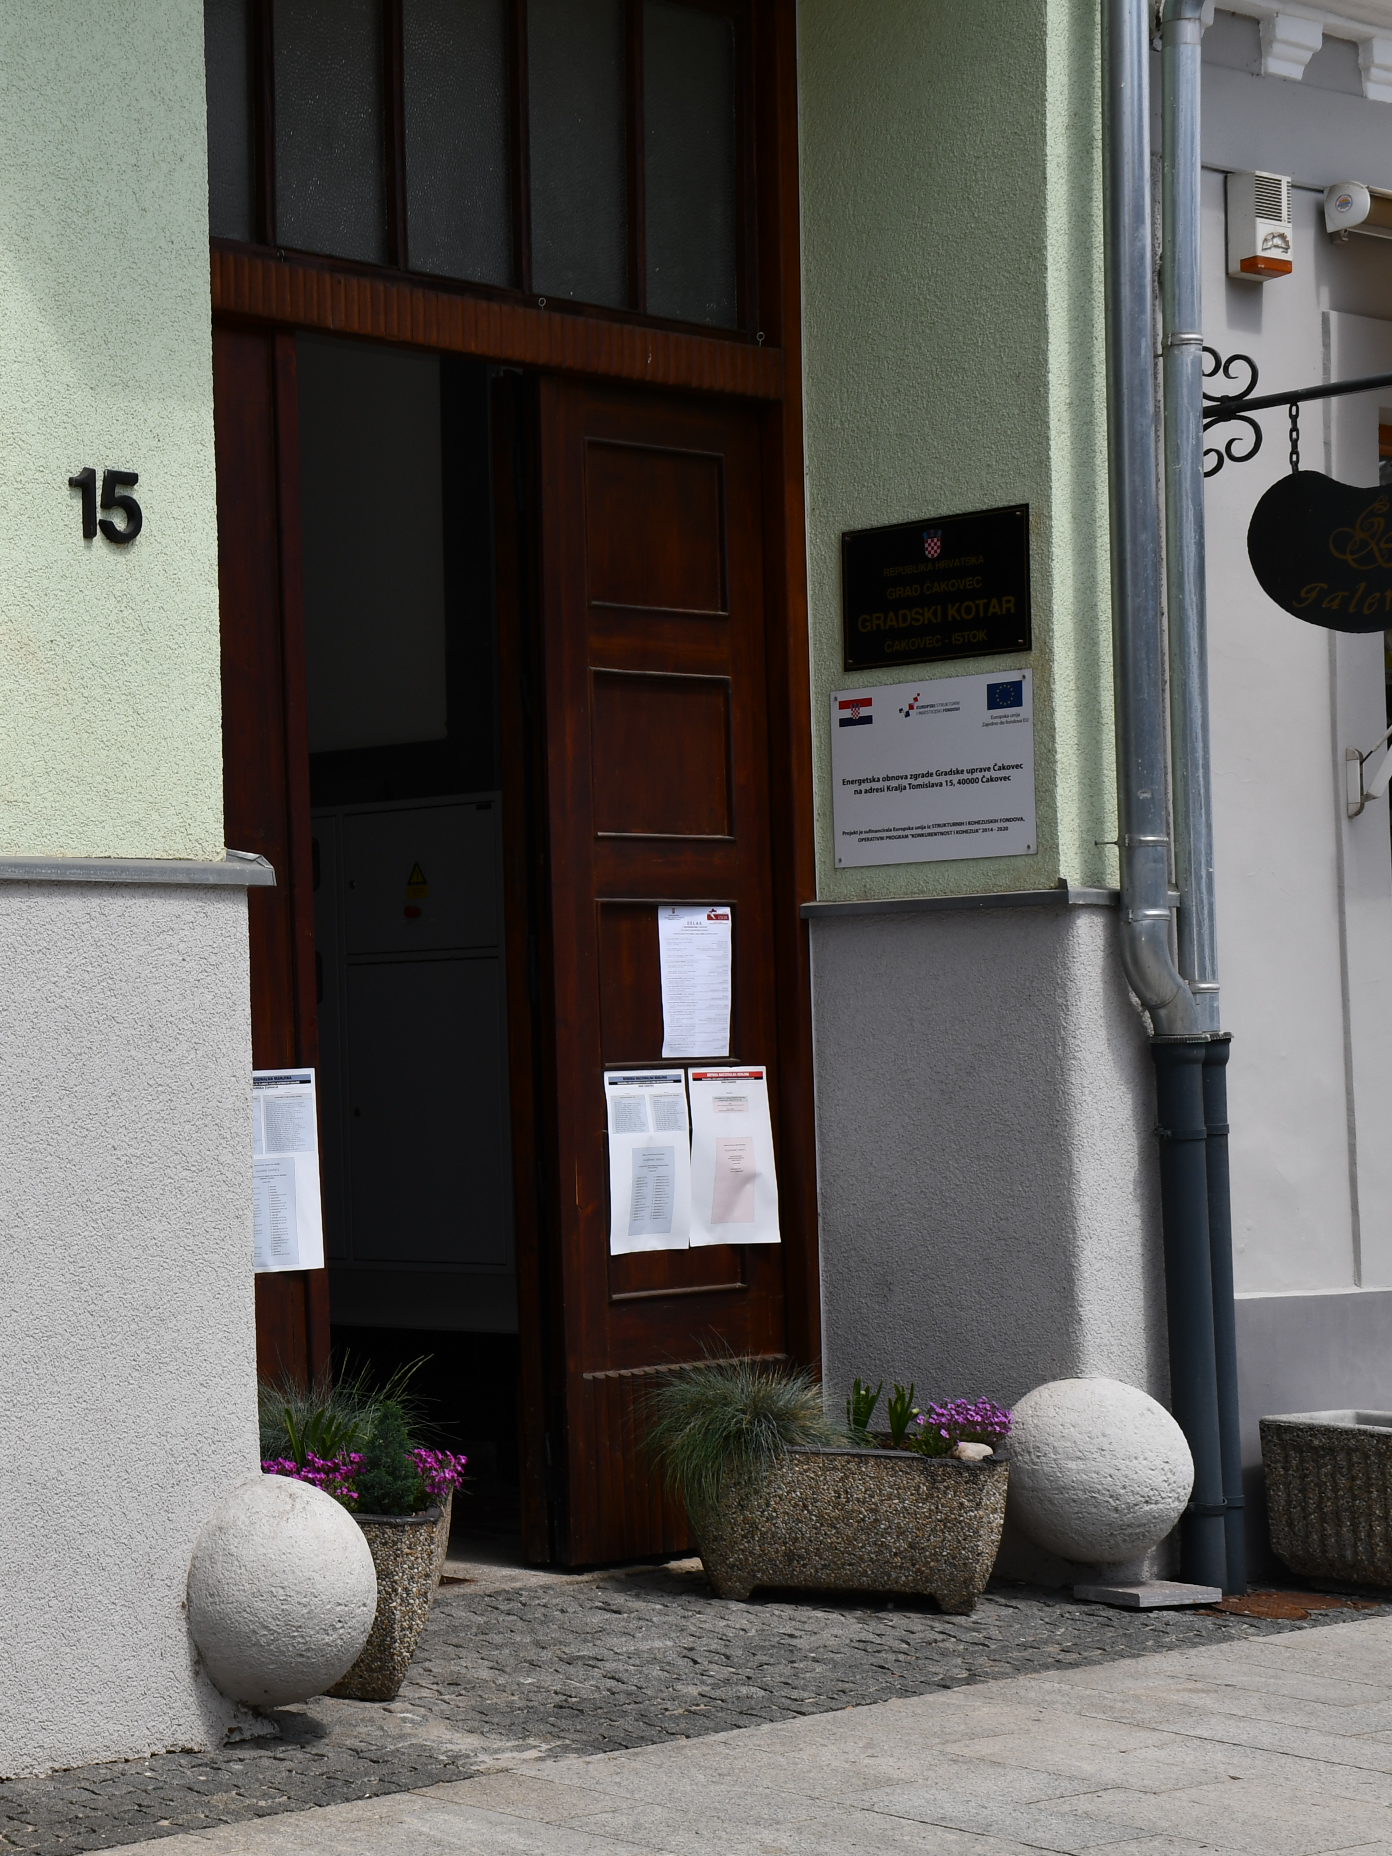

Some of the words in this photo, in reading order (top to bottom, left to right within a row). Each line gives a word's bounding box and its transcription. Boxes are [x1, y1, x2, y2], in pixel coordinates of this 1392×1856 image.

[68, 467, 142, 543] 15
[883, 564, 933, 577] REPUBLIKA
[935, 556, 985, 570] HRVATSKA
[886, 585, 921, 600] GRAD
[858, 605, 943, 632] GRADSKI
[948, 596, 1015, 621] KOTAR
[952, 629, 988, 645] ISTOK
[842, 774, 881, 787] Energetska
[882, 772, 908, 782] obnova
[909, 770, 934, 781] zgrade
[935, 767, 965, 777] Gradske
[966, 766, 991, 776] uprave
[992, 762, 1024, 772] Čakovec
[854, 787, 863, 795] na
[864, 785, 886, 794] adresi
[886, 783, 907, 793] Kralja
[908, 780, 943, 790] Tomislava
[945, 779, 955, 788] 15,
[957, 776, 980, 786] 40000
[980, 774, 1011, 784] Čakovec
